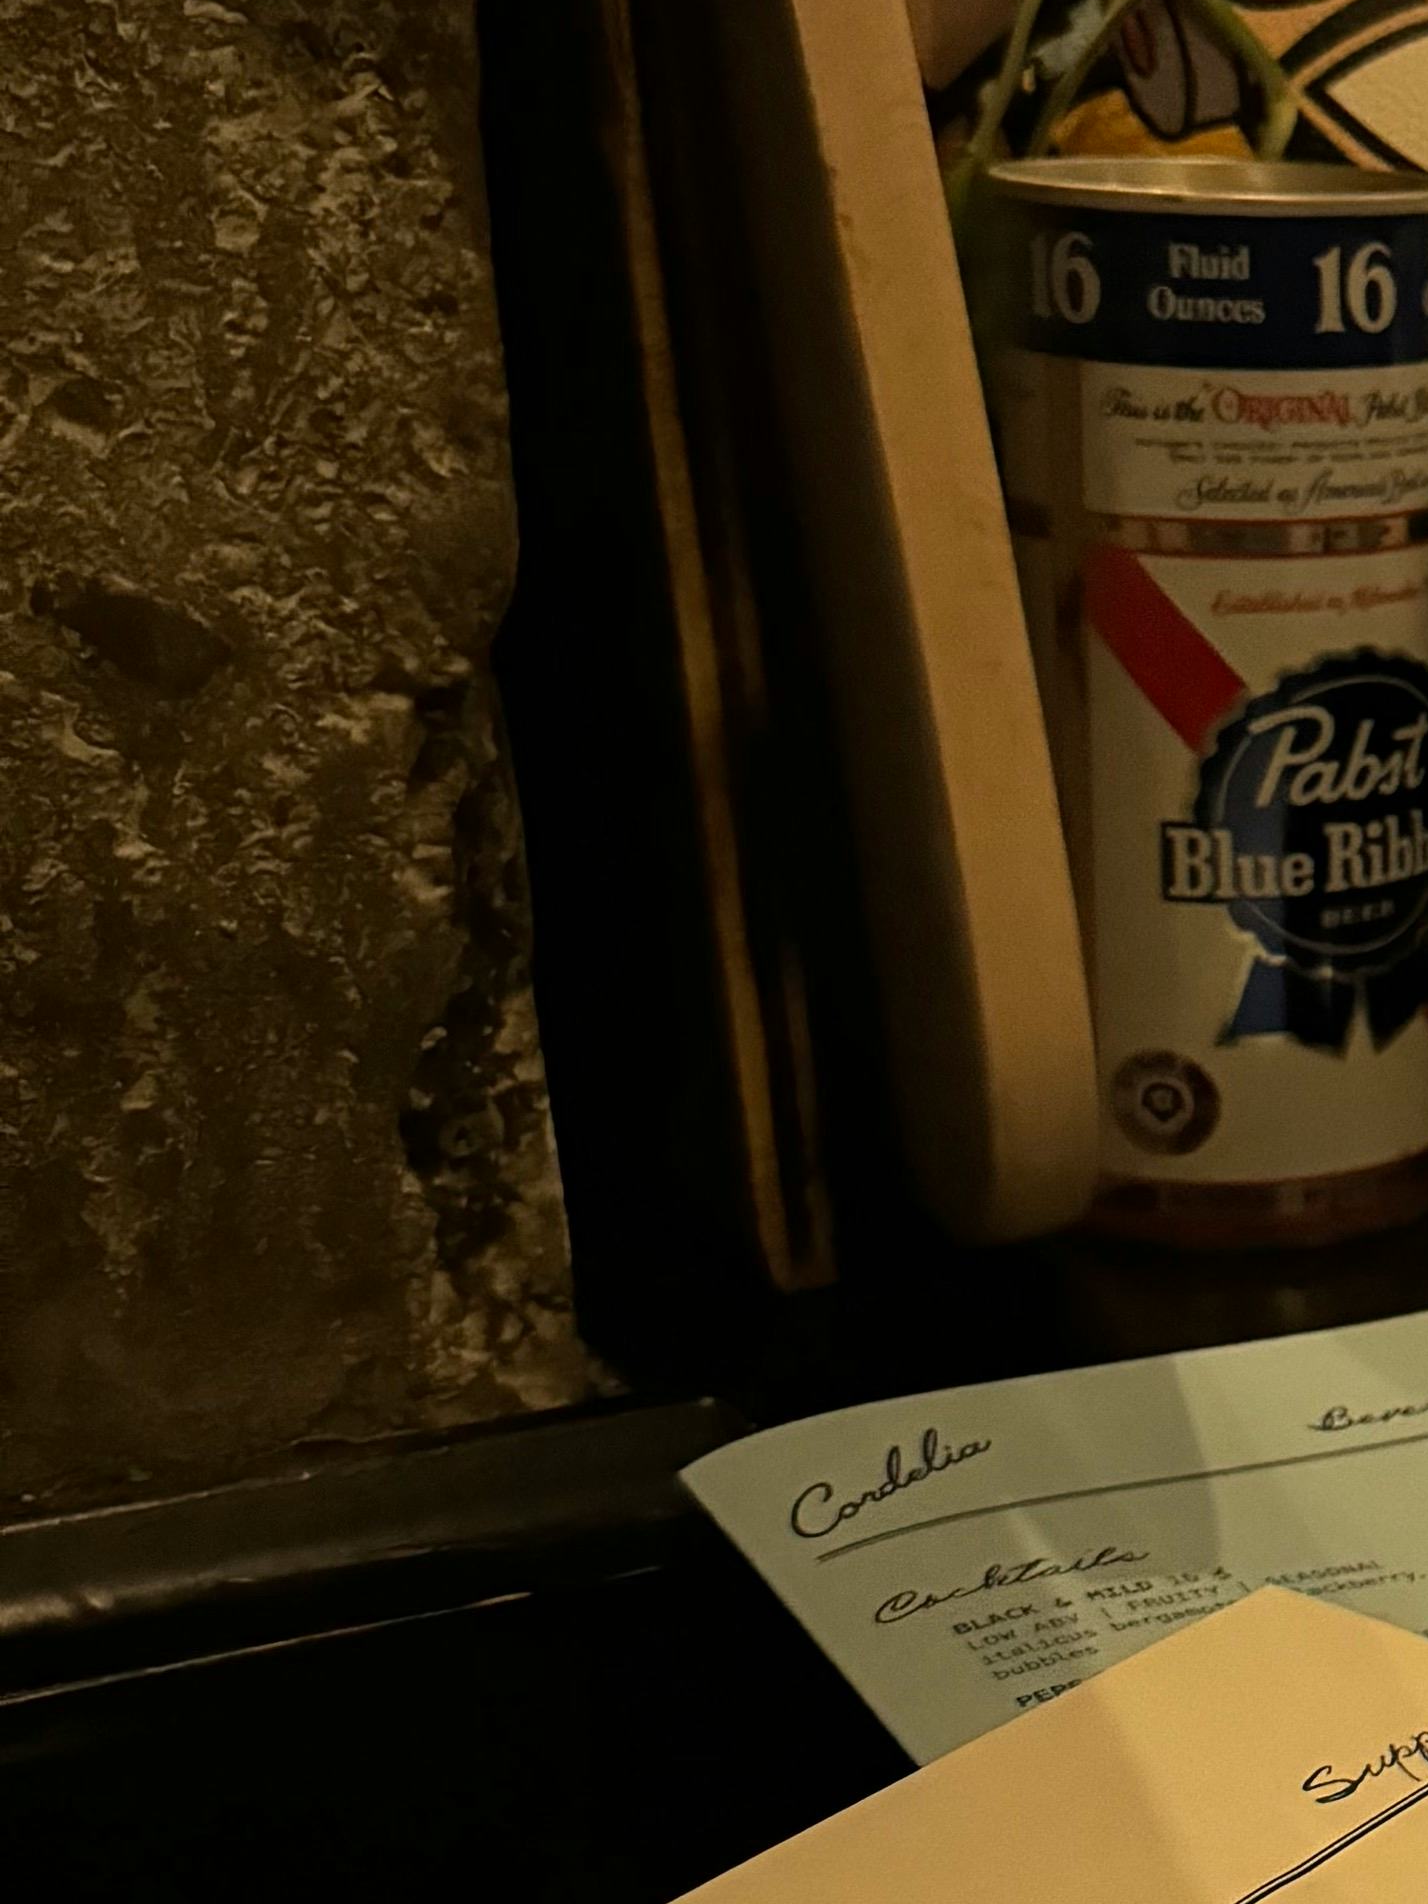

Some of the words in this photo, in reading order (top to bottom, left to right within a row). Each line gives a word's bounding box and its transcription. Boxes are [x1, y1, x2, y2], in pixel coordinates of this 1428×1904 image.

[1146, 285, 1266, 324] Ounces
[1167, 241, 1250, 281] Fluid
[1312, 241, 1398, 335] 16
[1167, 826, 1315, 900] Blue
[789, 1427, 992, 1538] Cordelia
[874, 1546, 1150, 1625] Cocktails
[953, 1605, 1038, 1636] BLACK
[1089, 1581, 1153, 1602] MILD
[968, 1629, 1018, 1651] LOW
[993, 1645, 1098, 1681] bubbles
